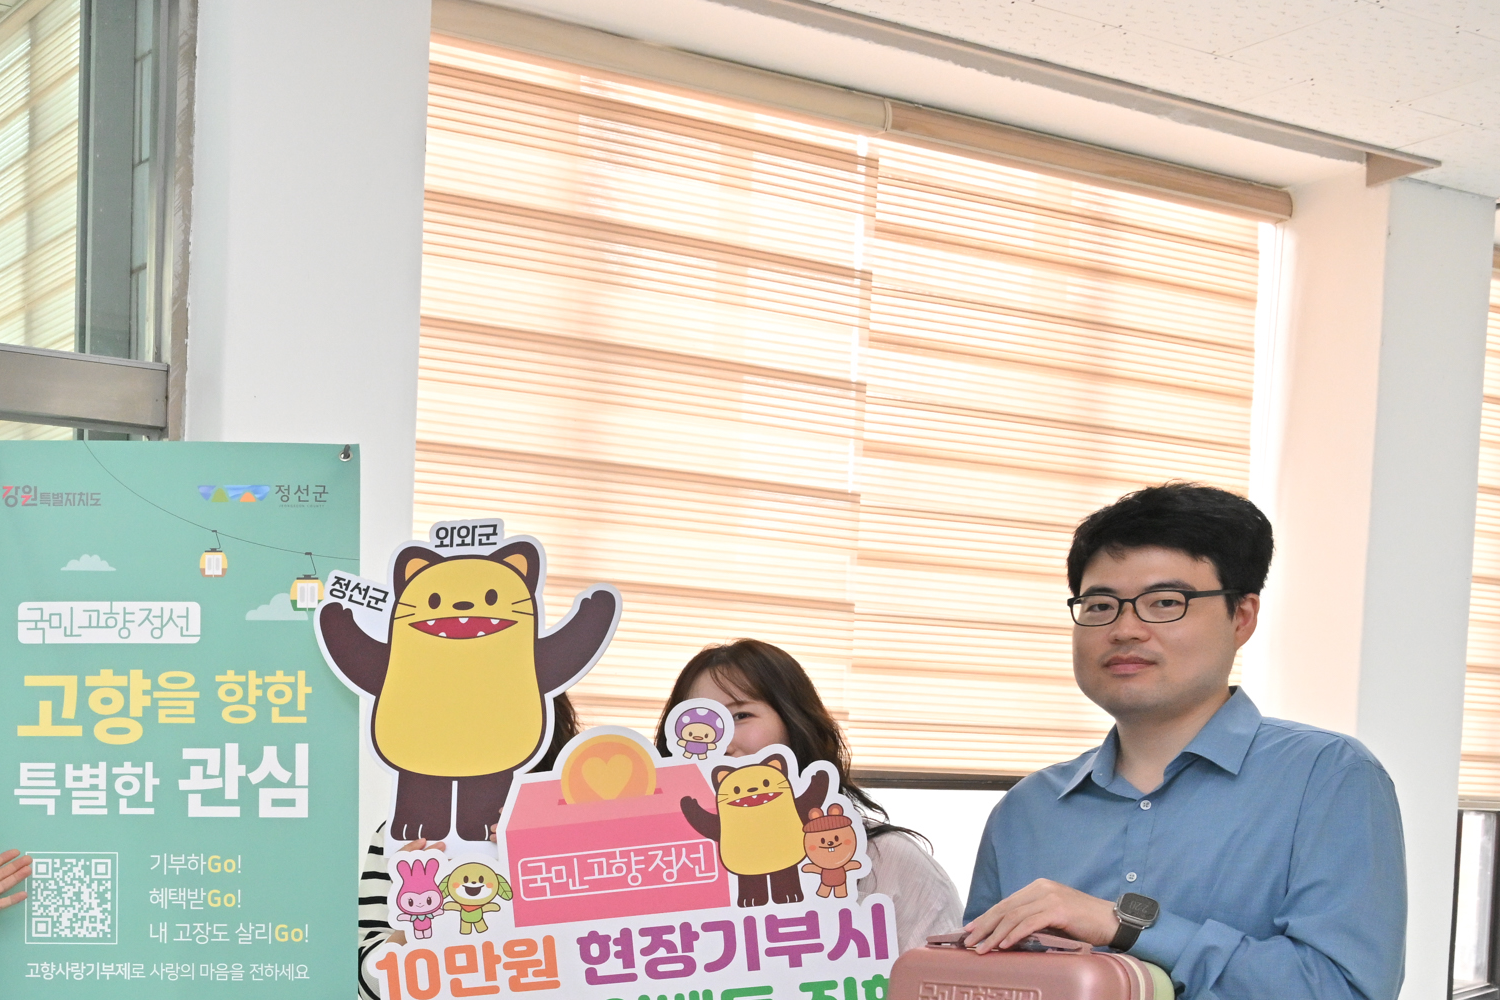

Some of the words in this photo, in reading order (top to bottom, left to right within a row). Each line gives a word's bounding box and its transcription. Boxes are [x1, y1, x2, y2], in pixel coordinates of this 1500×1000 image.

[2, 485, 101, 508] 강원특별자치도
[275, 485, 328, 502] 정선군
[435, 524, 499, 548] 와와군
[329, 575, 389, 612] 정선군
[18, 603, 200, 643] 국민고향정선
[17, 669, 200, 745] 고향을
[215, 670, 312, 724] 향한
[14, 761, 160, 816] 특별한
[178, 743, 309, 818] 관심
[151, 853, 241, 875] 기부하Go!
[521, 844, 716, 897] 국민고향정선
[149, 888, 241, 909] 혜택받Go!
[150, 922, 167, 943] 내
[173, 922, 230, 944] 고장도
[235, 923, 308, 944] 살리Go!
[576, 902, 891, 986] 현장기부시
[25, 962, 146, 980] 고향사랑기부제로
[150, 963, 194, 981] 사랑의
[200, 963, 245, 981] 마음을
[250, 963, 310, 981] 전하세요
